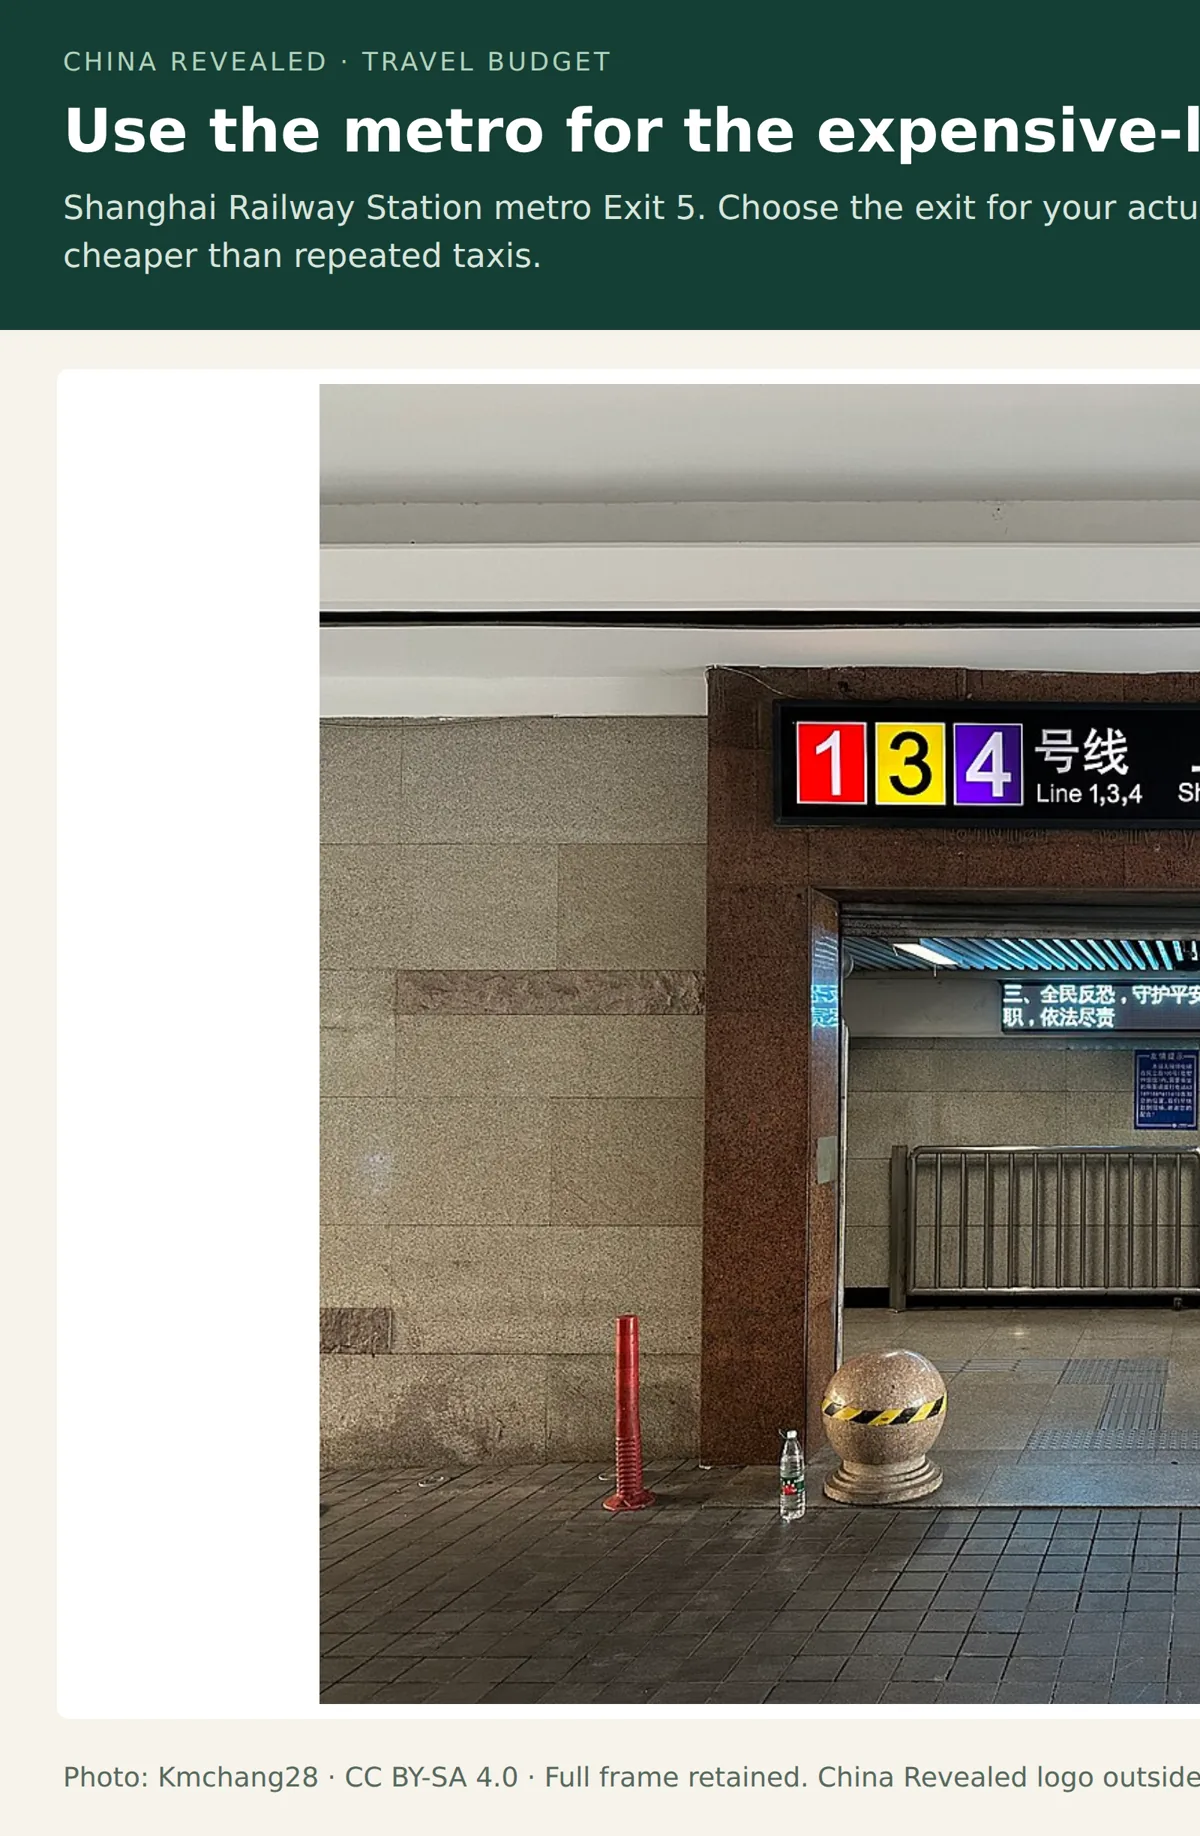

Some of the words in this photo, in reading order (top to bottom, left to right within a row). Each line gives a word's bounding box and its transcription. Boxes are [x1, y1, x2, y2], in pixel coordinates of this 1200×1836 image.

[815, 730, 842, 796] 1
[889, 731, 932, 796] 3
[965, 731, 1012, 797] 4
[1035, 728, 1129, 775] 号线
[1037, 783, 1082, 803] Line
[1089, 783, 1143, 807] 1,3,4
